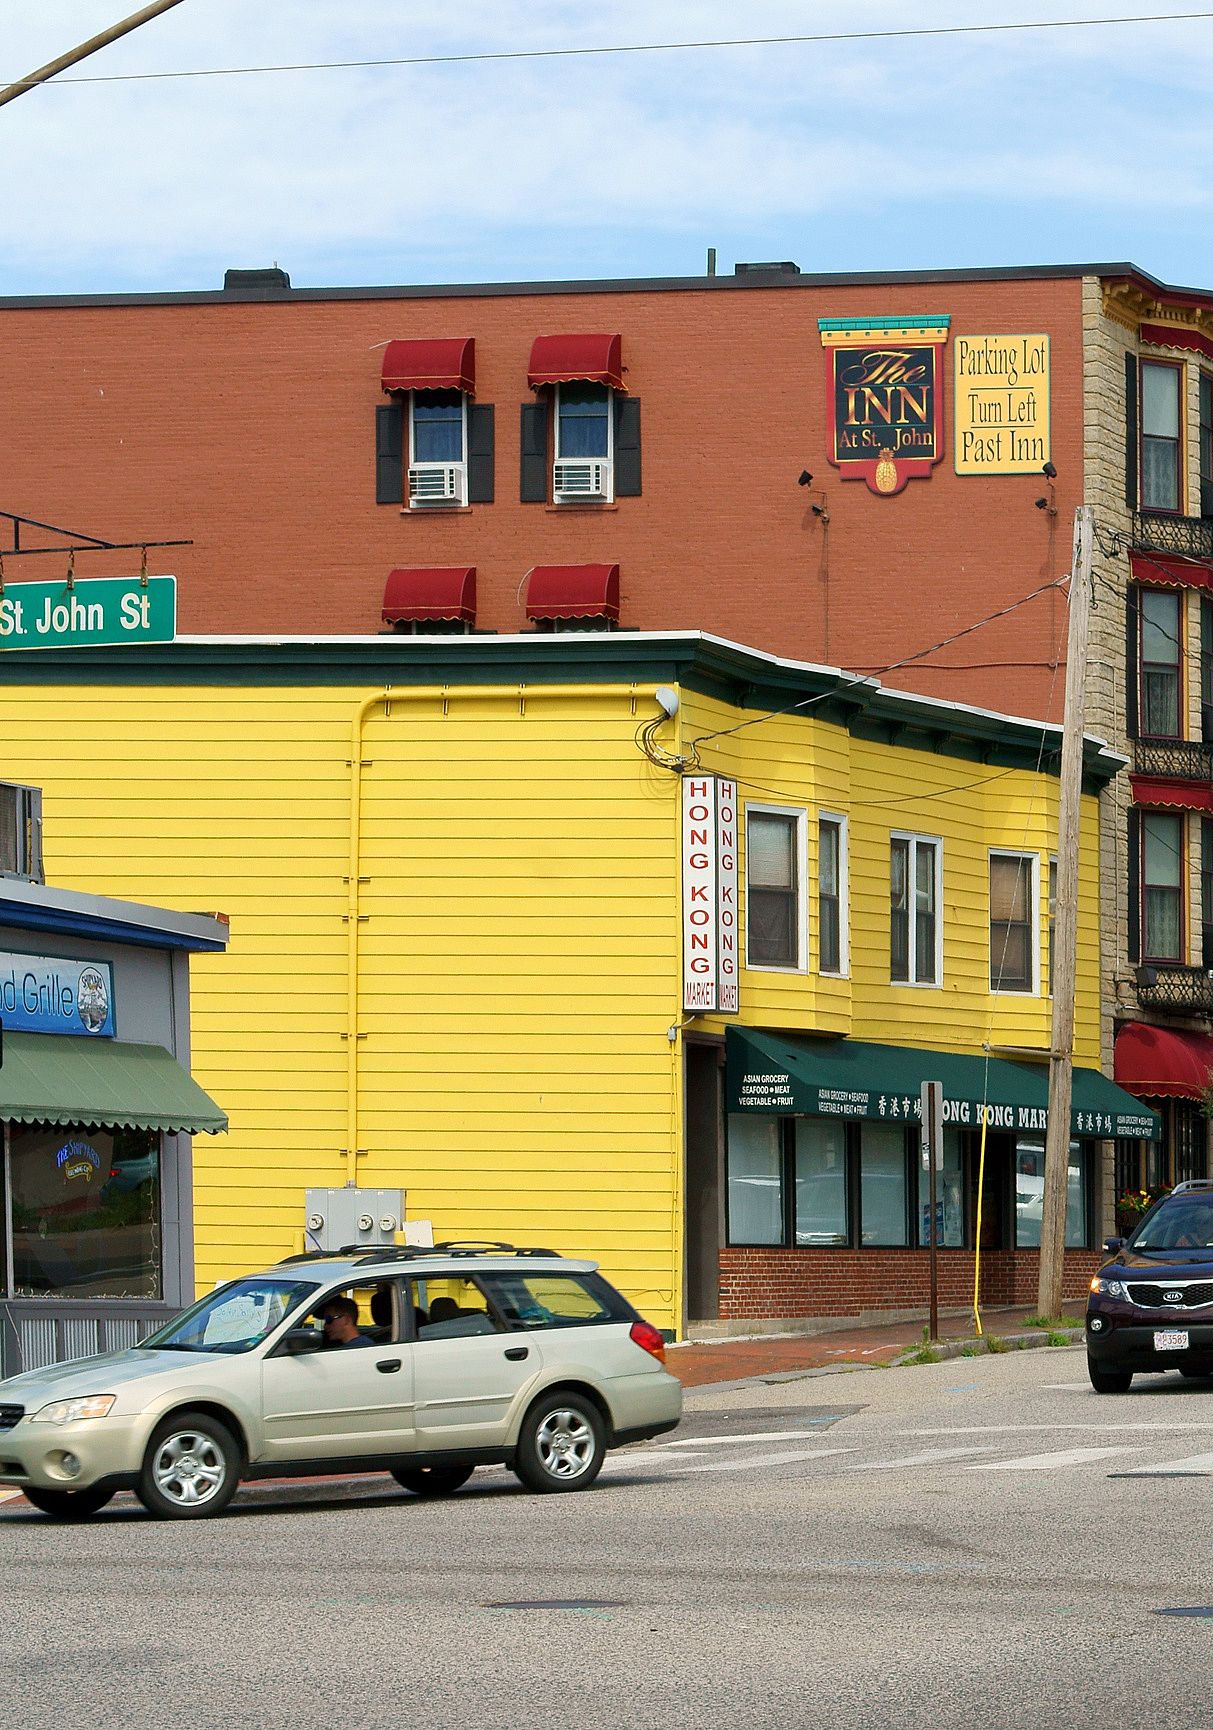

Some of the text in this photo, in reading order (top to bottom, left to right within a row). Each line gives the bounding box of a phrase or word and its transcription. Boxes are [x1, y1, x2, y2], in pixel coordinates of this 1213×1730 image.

[840, 351, 926, 385] The
[959, 338, 1045, 385] Parking Lot
[844, 385, 929, 425] INN
[968, 392, 1037, 423] Turn Left
[839, 428, 933, 450] At St. John
[962, 430, 1045, 462] Past Inn
[0, 593, 151, 636] St. John St
[689, 782, 709, 870] HONG
[721, 782, 733, 871] HONG
[689, 886, 710, 973] KONG
[722, 886, 734, 975] KONG
[23, 973, 73, 1016] Grille
[686, 982, 714, 1006] MARKET
[742, 1085, 790, 1094] SEAFOOD MEAT
[743, 1074, 789, 1083] ASIAN GROCERY
[739, 1096, 794, 1105] VEGETABLE FRUIT
[942, 1099, 970, 1123] ONG
[1018, 1107, 1049, 1129] MAR
